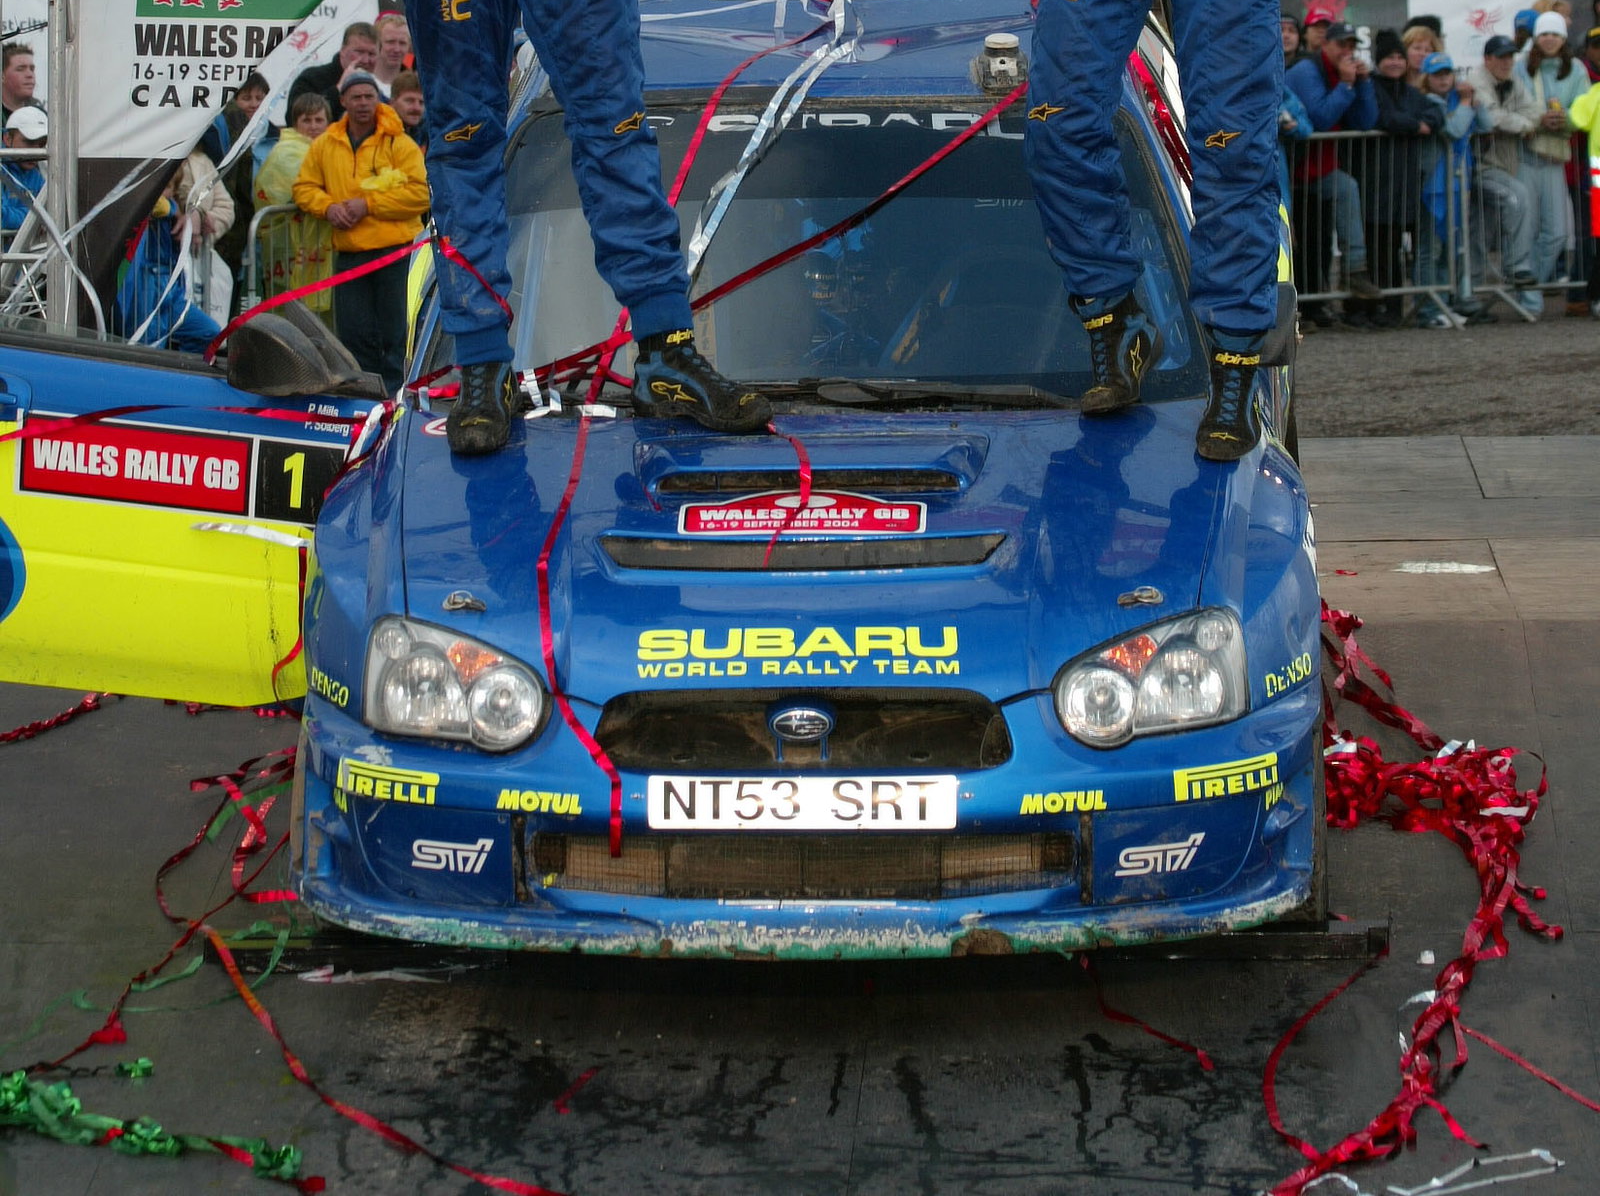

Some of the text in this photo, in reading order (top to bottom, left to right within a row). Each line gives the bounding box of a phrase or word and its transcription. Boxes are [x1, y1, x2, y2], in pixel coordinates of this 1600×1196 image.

[134, 23, 238, 59] WALES
[133, 63, 190, 81] 16-19
[314, 421, 350, 437] Solberg
[33, 437, 240, 491] WALES RALLY GB
[283, 452, 305, 509] 1
[699, 508, 787, 520] WALES
[873, 508, 910, 520] GB
[699, 521, 738, 529] 16-19
[823, 520, 860, 528] 2004
[637, 626, 959, 661] SUBARU
[637, 659, 960, 679] WORLD RALLY TEAM
[336, 754, 440, 805] PIRELLI
[1173, 751, 1278, 802] PIRELLI
[496, 789, 582, 815] MOTUL
[662, 780, 940, 821] NT53 SRT
[1019, 789, 1107, 815] MOTUL
